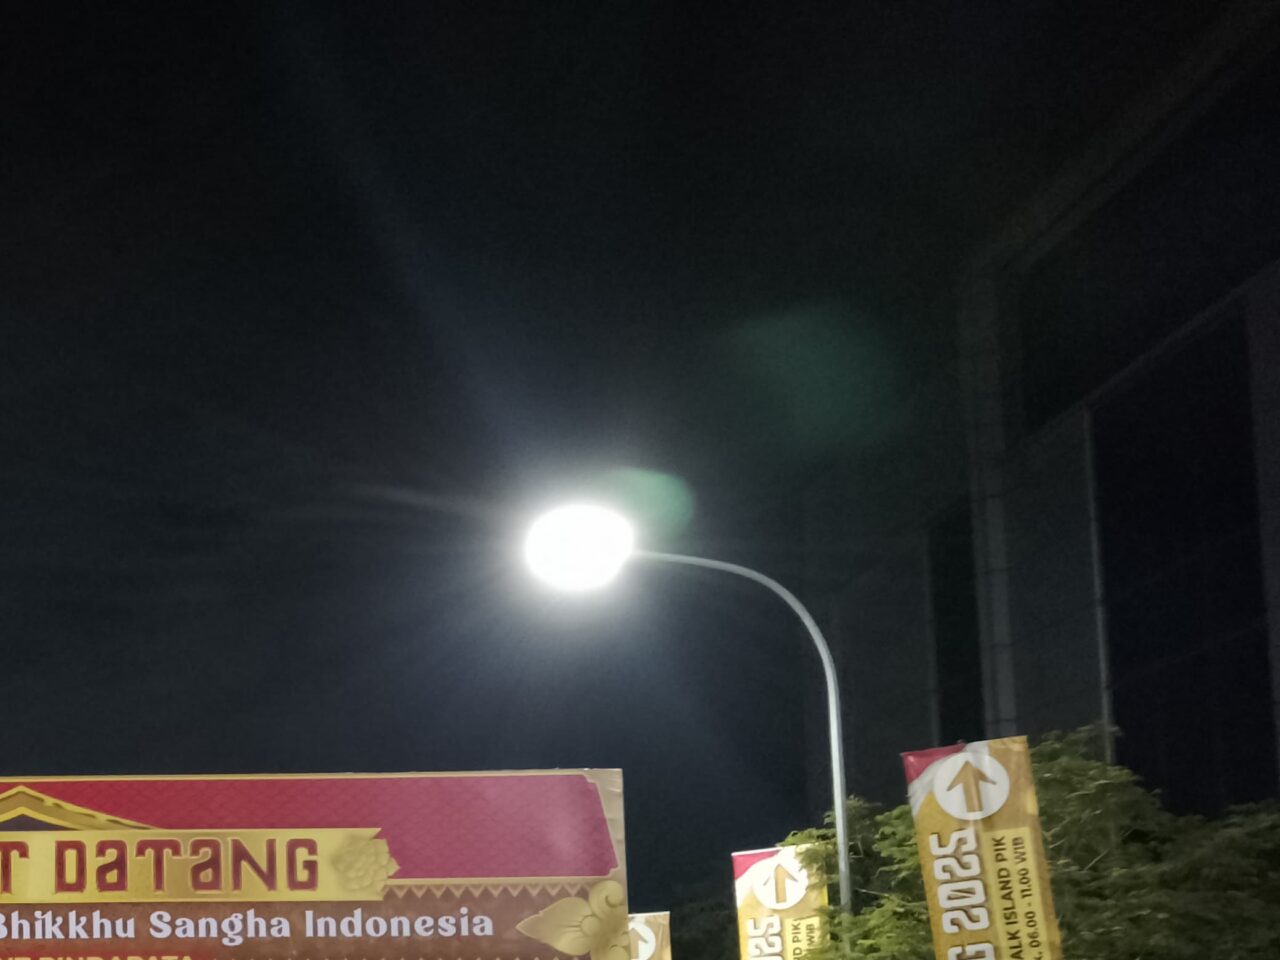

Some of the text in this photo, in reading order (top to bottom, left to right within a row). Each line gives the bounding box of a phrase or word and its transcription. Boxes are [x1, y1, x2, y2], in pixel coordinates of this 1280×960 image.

[992, 836, 1008, 863] PIK
[1012, 836, 1026, 864] WIB
[928, 827, 990, 934] 2025
[997, 867, 1019, 925] ISLAND
[1018, 868, 1032, 899] 11.00
[149, 908, 290, 946] Sangha
[305, 906, 494, 938] Indonesia
[791, 921, 802, 944] PIK
[806, 923, 817, 946] WIB
[1025, 910, 1041, 948] 06.00
